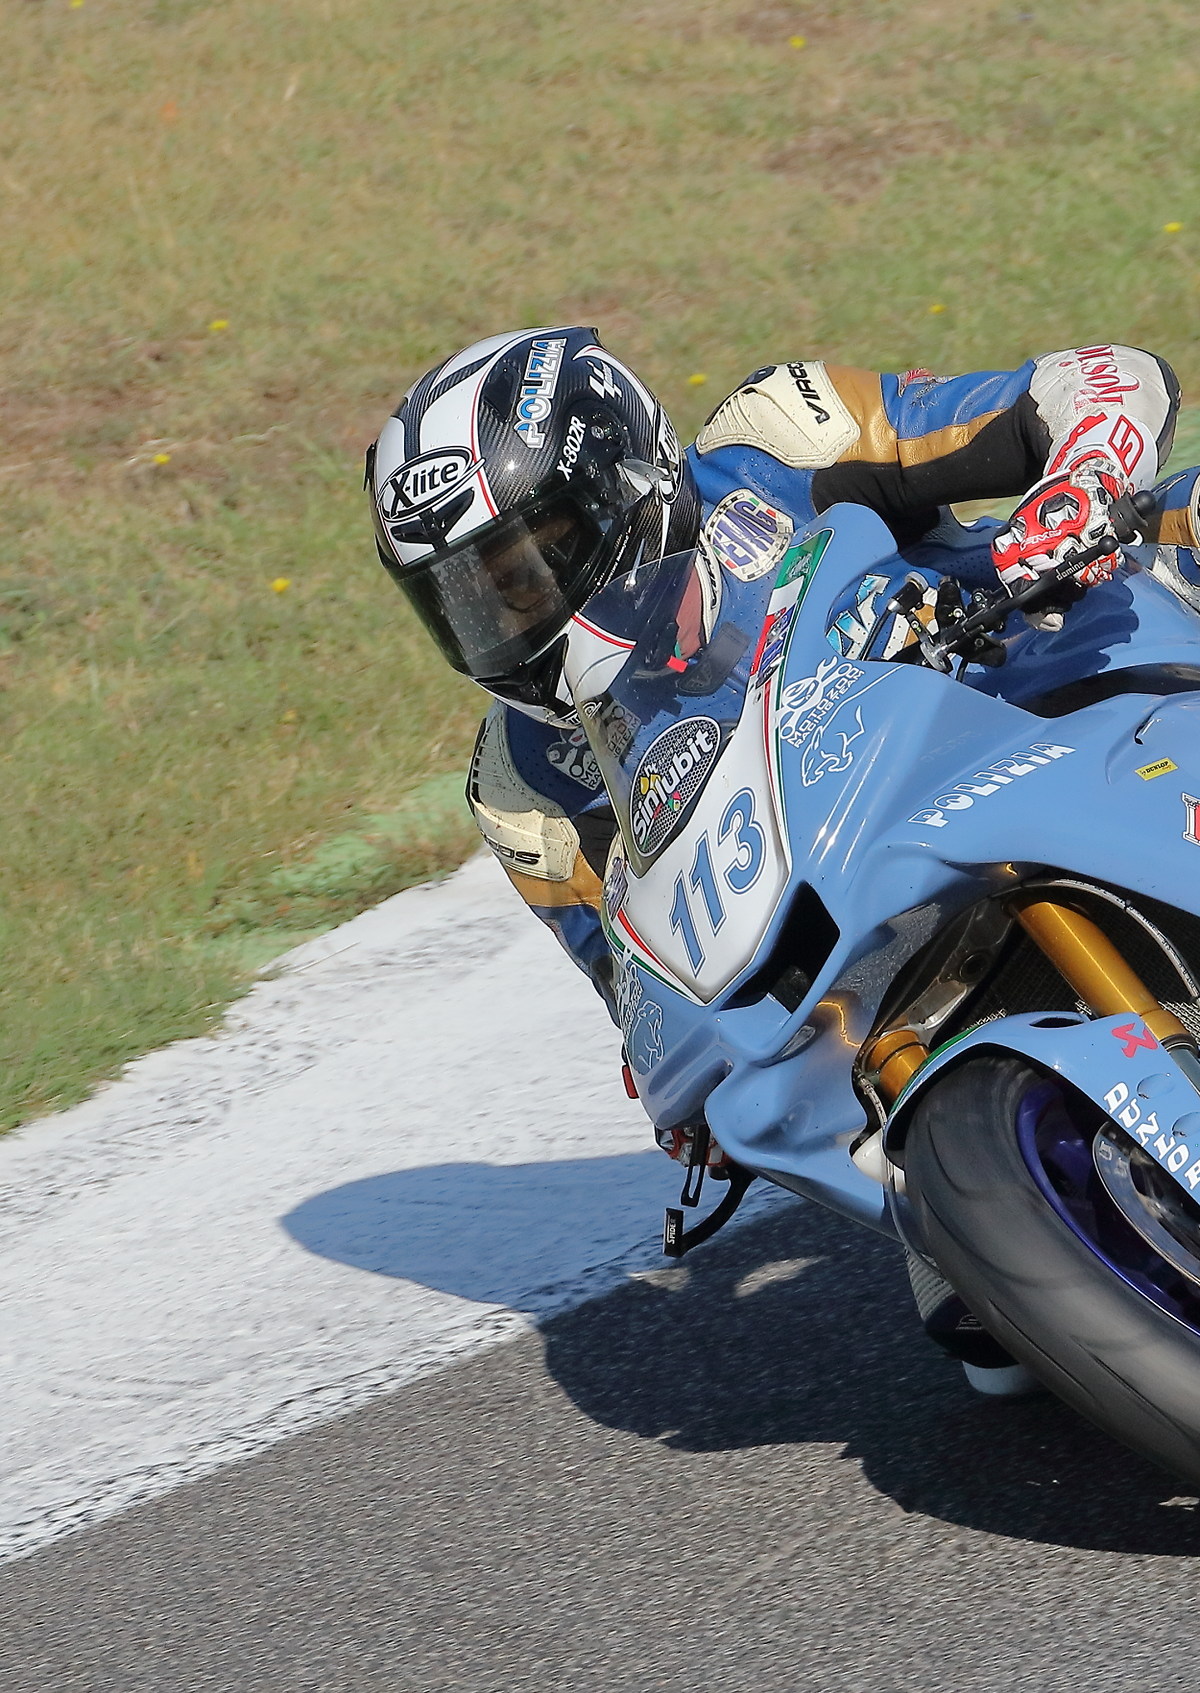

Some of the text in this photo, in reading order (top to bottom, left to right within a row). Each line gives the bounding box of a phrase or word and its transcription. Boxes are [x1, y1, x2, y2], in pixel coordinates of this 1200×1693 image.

[513, 337, 567, 449] POLIZIA
[556, 415, 587, 481] X-802R
[388, 461, 460, 518] X-lite
[830, 669, 866, 701] TEAM
[907, 743, 1077, 828] POLIZIA
[669, 786, 767, 979] 113
